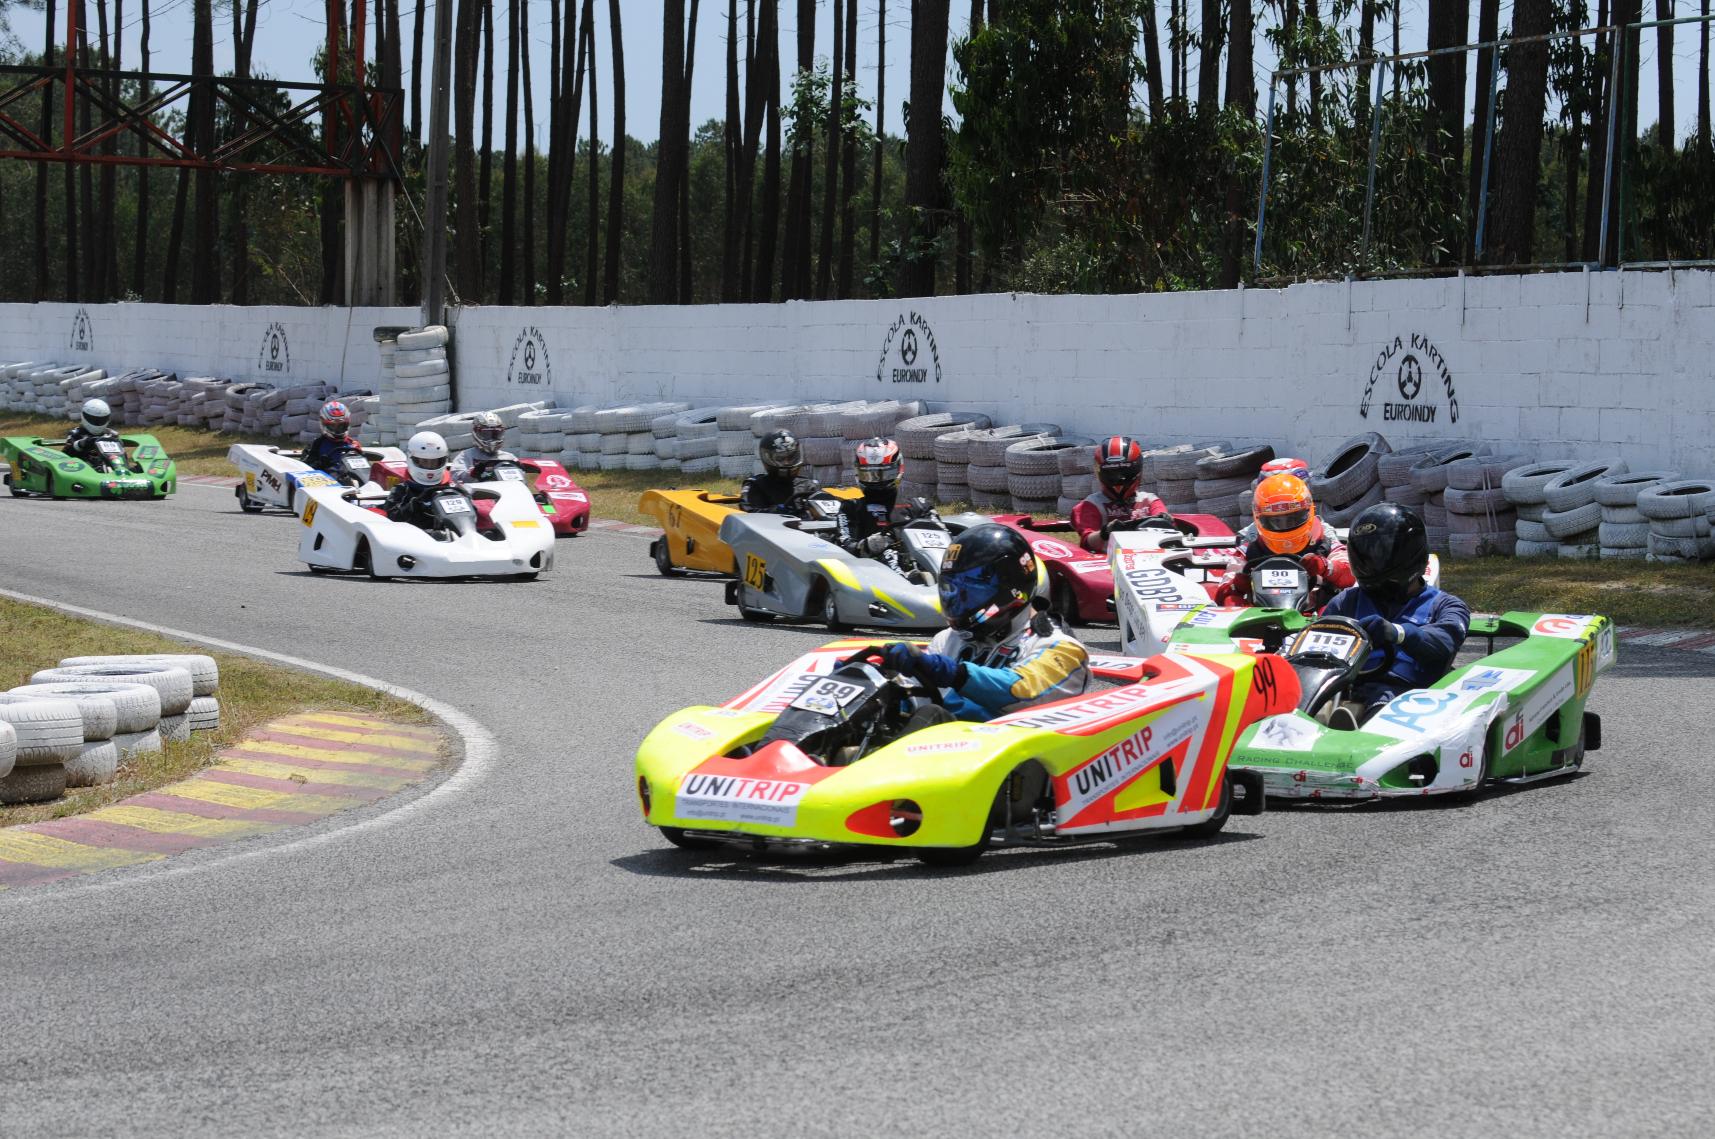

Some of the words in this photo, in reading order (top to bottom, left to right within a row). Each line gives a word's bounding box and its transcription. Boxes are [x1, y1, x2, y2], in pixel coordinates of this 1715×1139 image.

[877, 313, 906, 382] ESCOLA
[910, 310, 942, 383] KARTING
[892, 368, 928, 383] EUROINDY
[1360, 336, 1403, 419] ESCOLA
[1410, 332, 1460, 424] KARTING
[1383, 402, 1437, 423] EUROINDY
[745, 554, 766, 590] 125
[1126, 568, 1183, 603] GDBP
[1312, 634, 1347, 646] 115
[815, 681, 856, 700] 99
[1252, 656, 1277, 713] 99
[1005, 686, 1148, 730] UNITRIP
[1075, 725, 1153, 796] UNITRIP
[1237, 755, 1281, 765] RACING
[685, 774, 801, 802] UNITRIP
